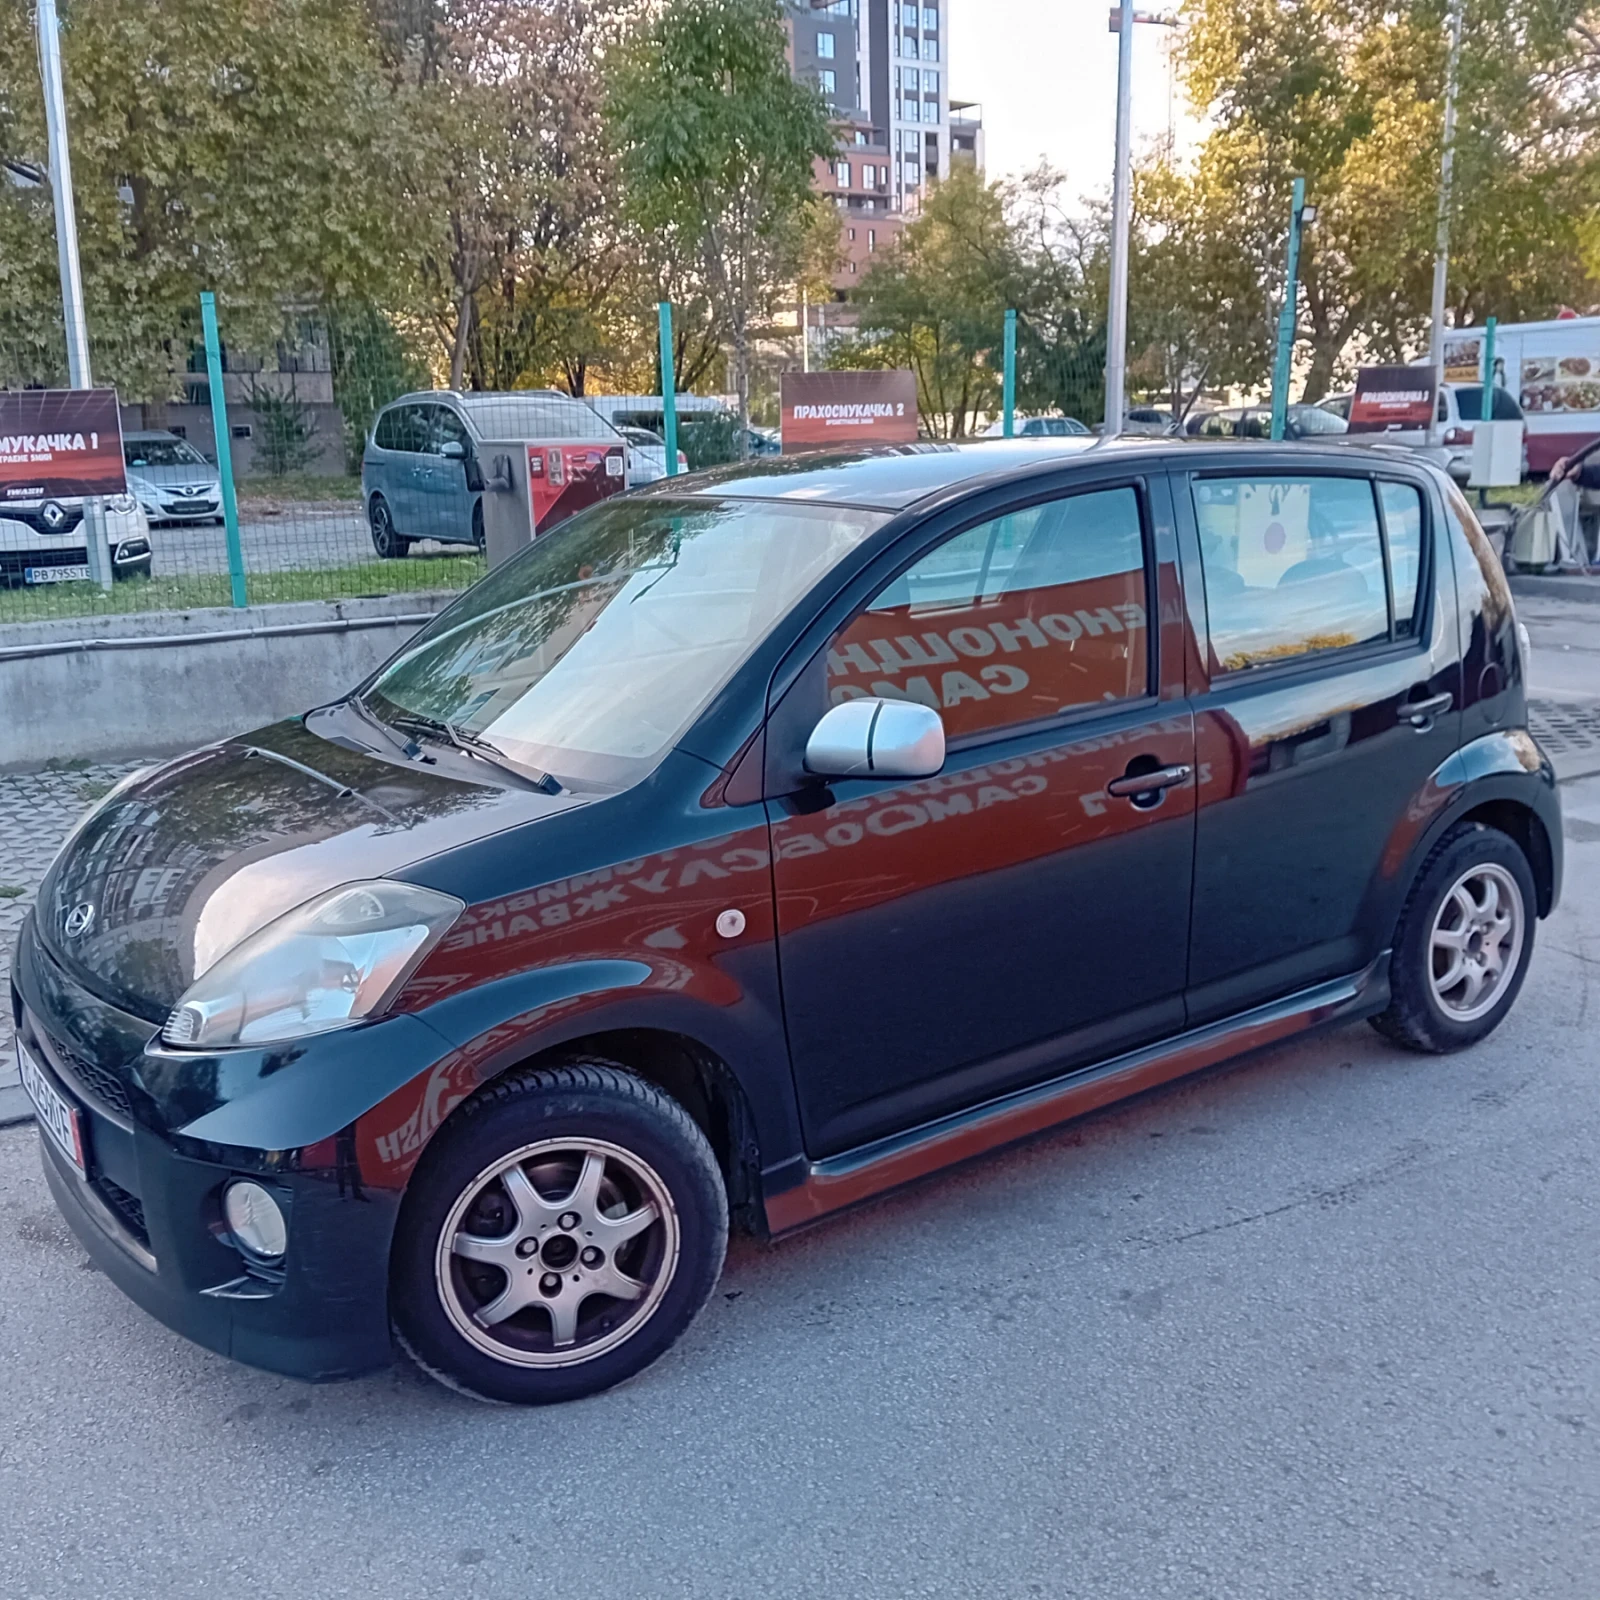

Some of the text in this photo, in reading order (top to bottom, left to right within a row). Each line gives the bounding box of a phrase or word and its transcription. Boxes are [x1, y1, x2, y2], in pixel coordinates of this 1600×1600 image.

[793, 402, 905, 419] ПРАХОСМУКАЧКА 2
[90, 431, 99, 450] 1
[33, 569, 49, 581] PB
